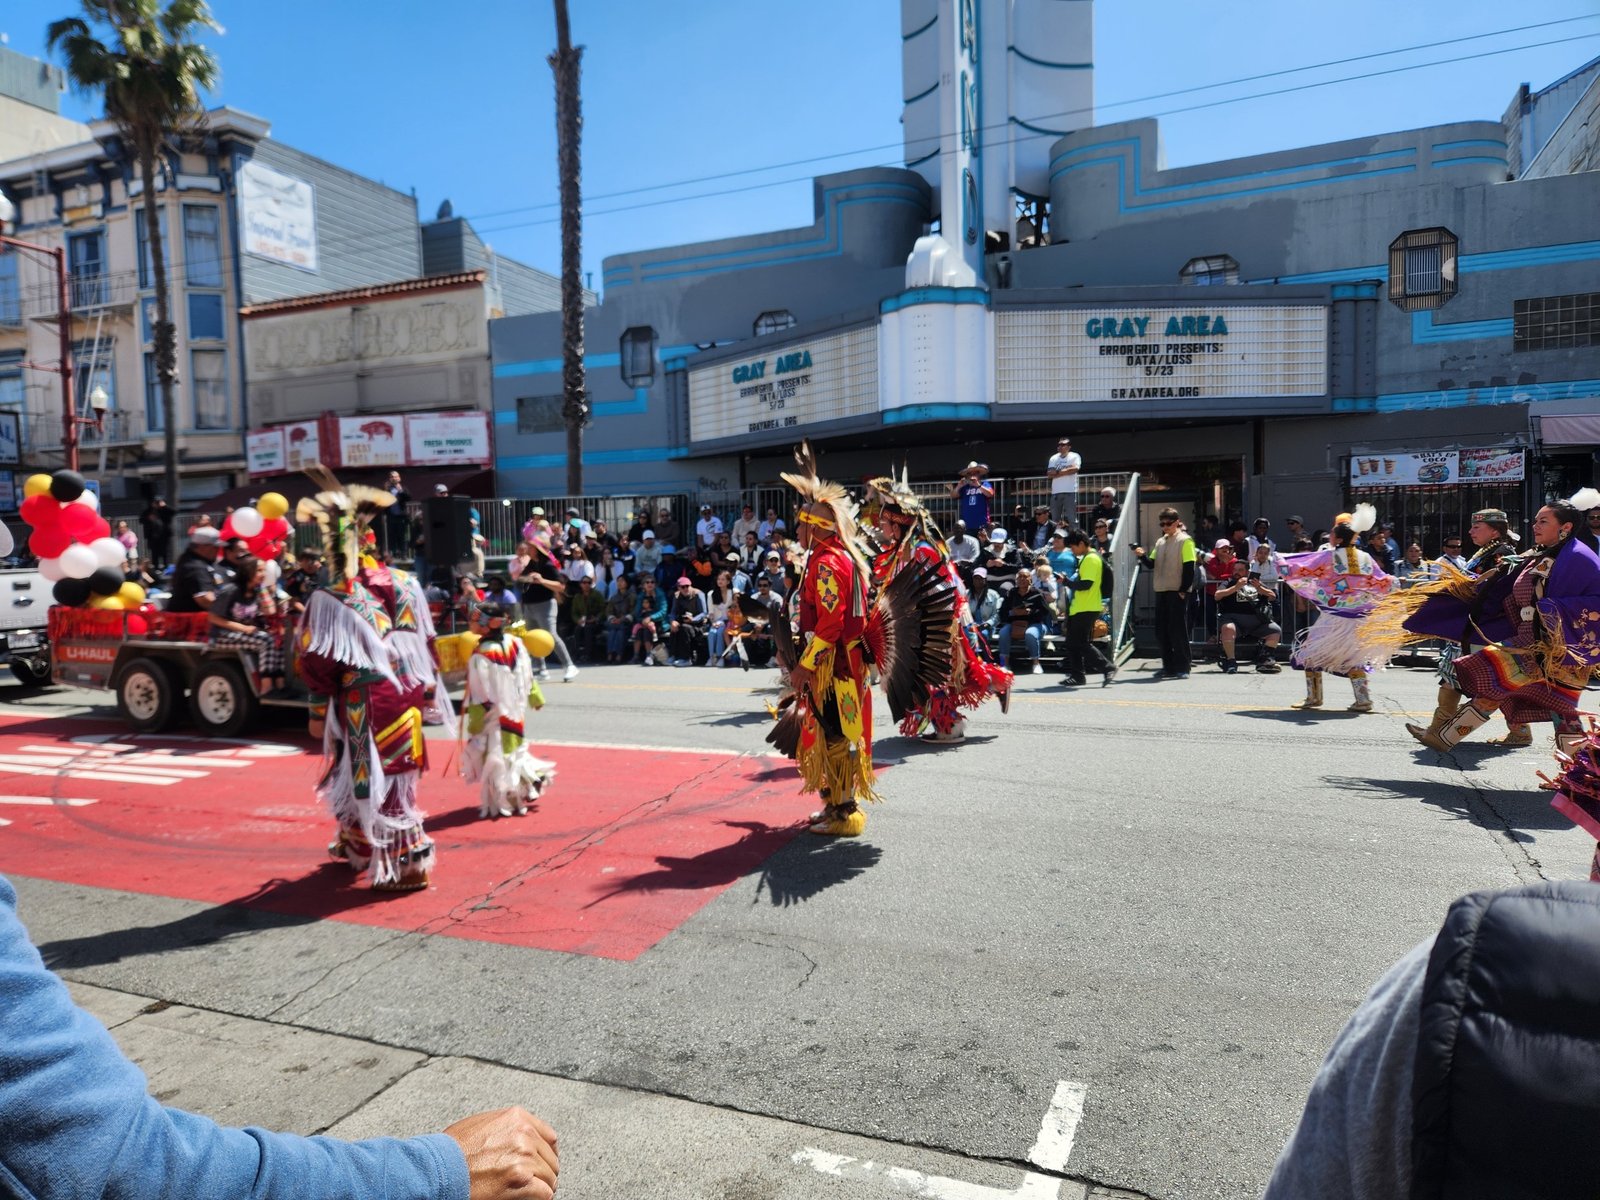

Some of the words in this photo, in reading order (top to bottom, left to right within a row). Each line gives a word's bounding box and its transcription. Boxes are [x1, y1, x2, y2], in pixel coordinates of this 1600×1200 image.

[1086, 316, 1150, 338] GRAY
[1164, 315, 1228, 337] AREA
[1099, 343, 1160, 355] ERRORGRID
[1166, 342, 1224, 354] PRESENTS:
[1126, 354, 1193, 366] DATA/LOSS
[733, 362, 766, 384] GRAY
[775, 350, 813, 375] AREA
[1145, 366, 1174, 377] 5/23
[777, 375, 811, 389] PRESENTS:
[759, 387, 796, 402] DATA/LOSS
[1111, 386, 1200, 399] GRAYAREA.ORG
[770, 399, 785, 410] 5/23
[748, 415, 797, 432] GRAYAREA.ORG
[1411, 452, 1442, 460] WHAT'S
[66, 647, 114, 661] U-HAUL
